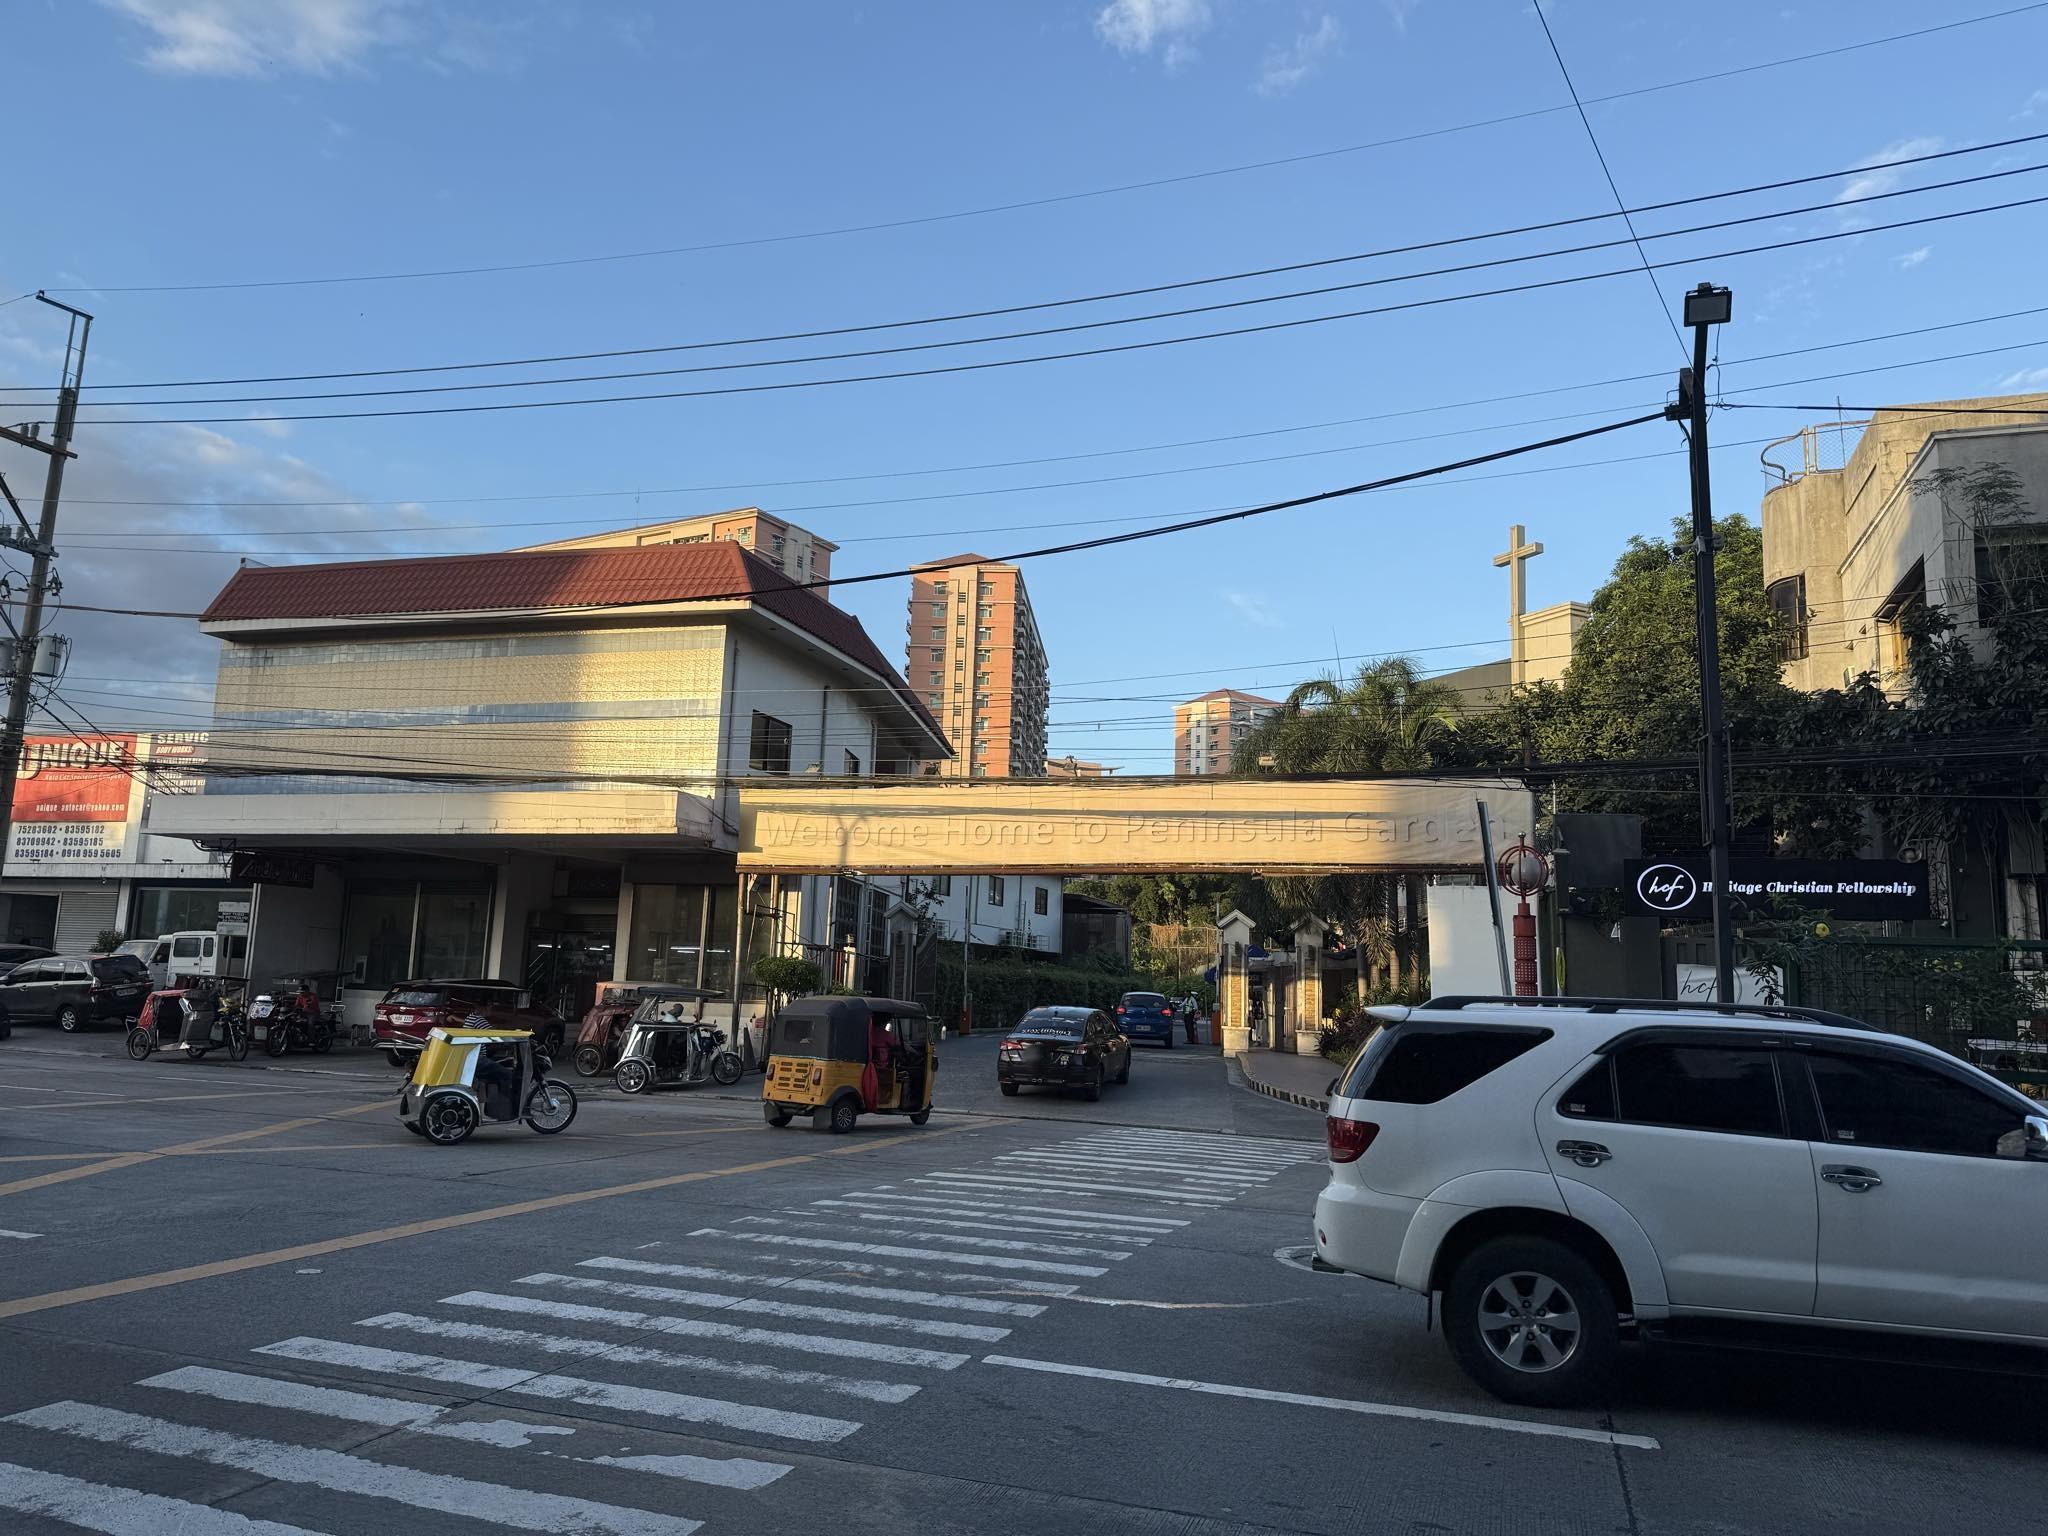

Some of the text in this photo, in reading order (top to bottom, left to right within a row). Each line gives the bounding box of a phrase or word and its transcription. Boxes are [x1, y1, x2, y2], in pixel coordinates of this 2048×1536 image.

[16, 742, 127, 779] UNIQUE
[766, 816, 931, 848] Welcome
[944, 816, 1054, 847] Home
[1072, 815, 1109, 845] to
[1125, 810, 1324, 844] Peninsula
[1648, 874, 1685, 902] hcf
[1702, 880, 1917, 896] Hitage Christian Fellowship
